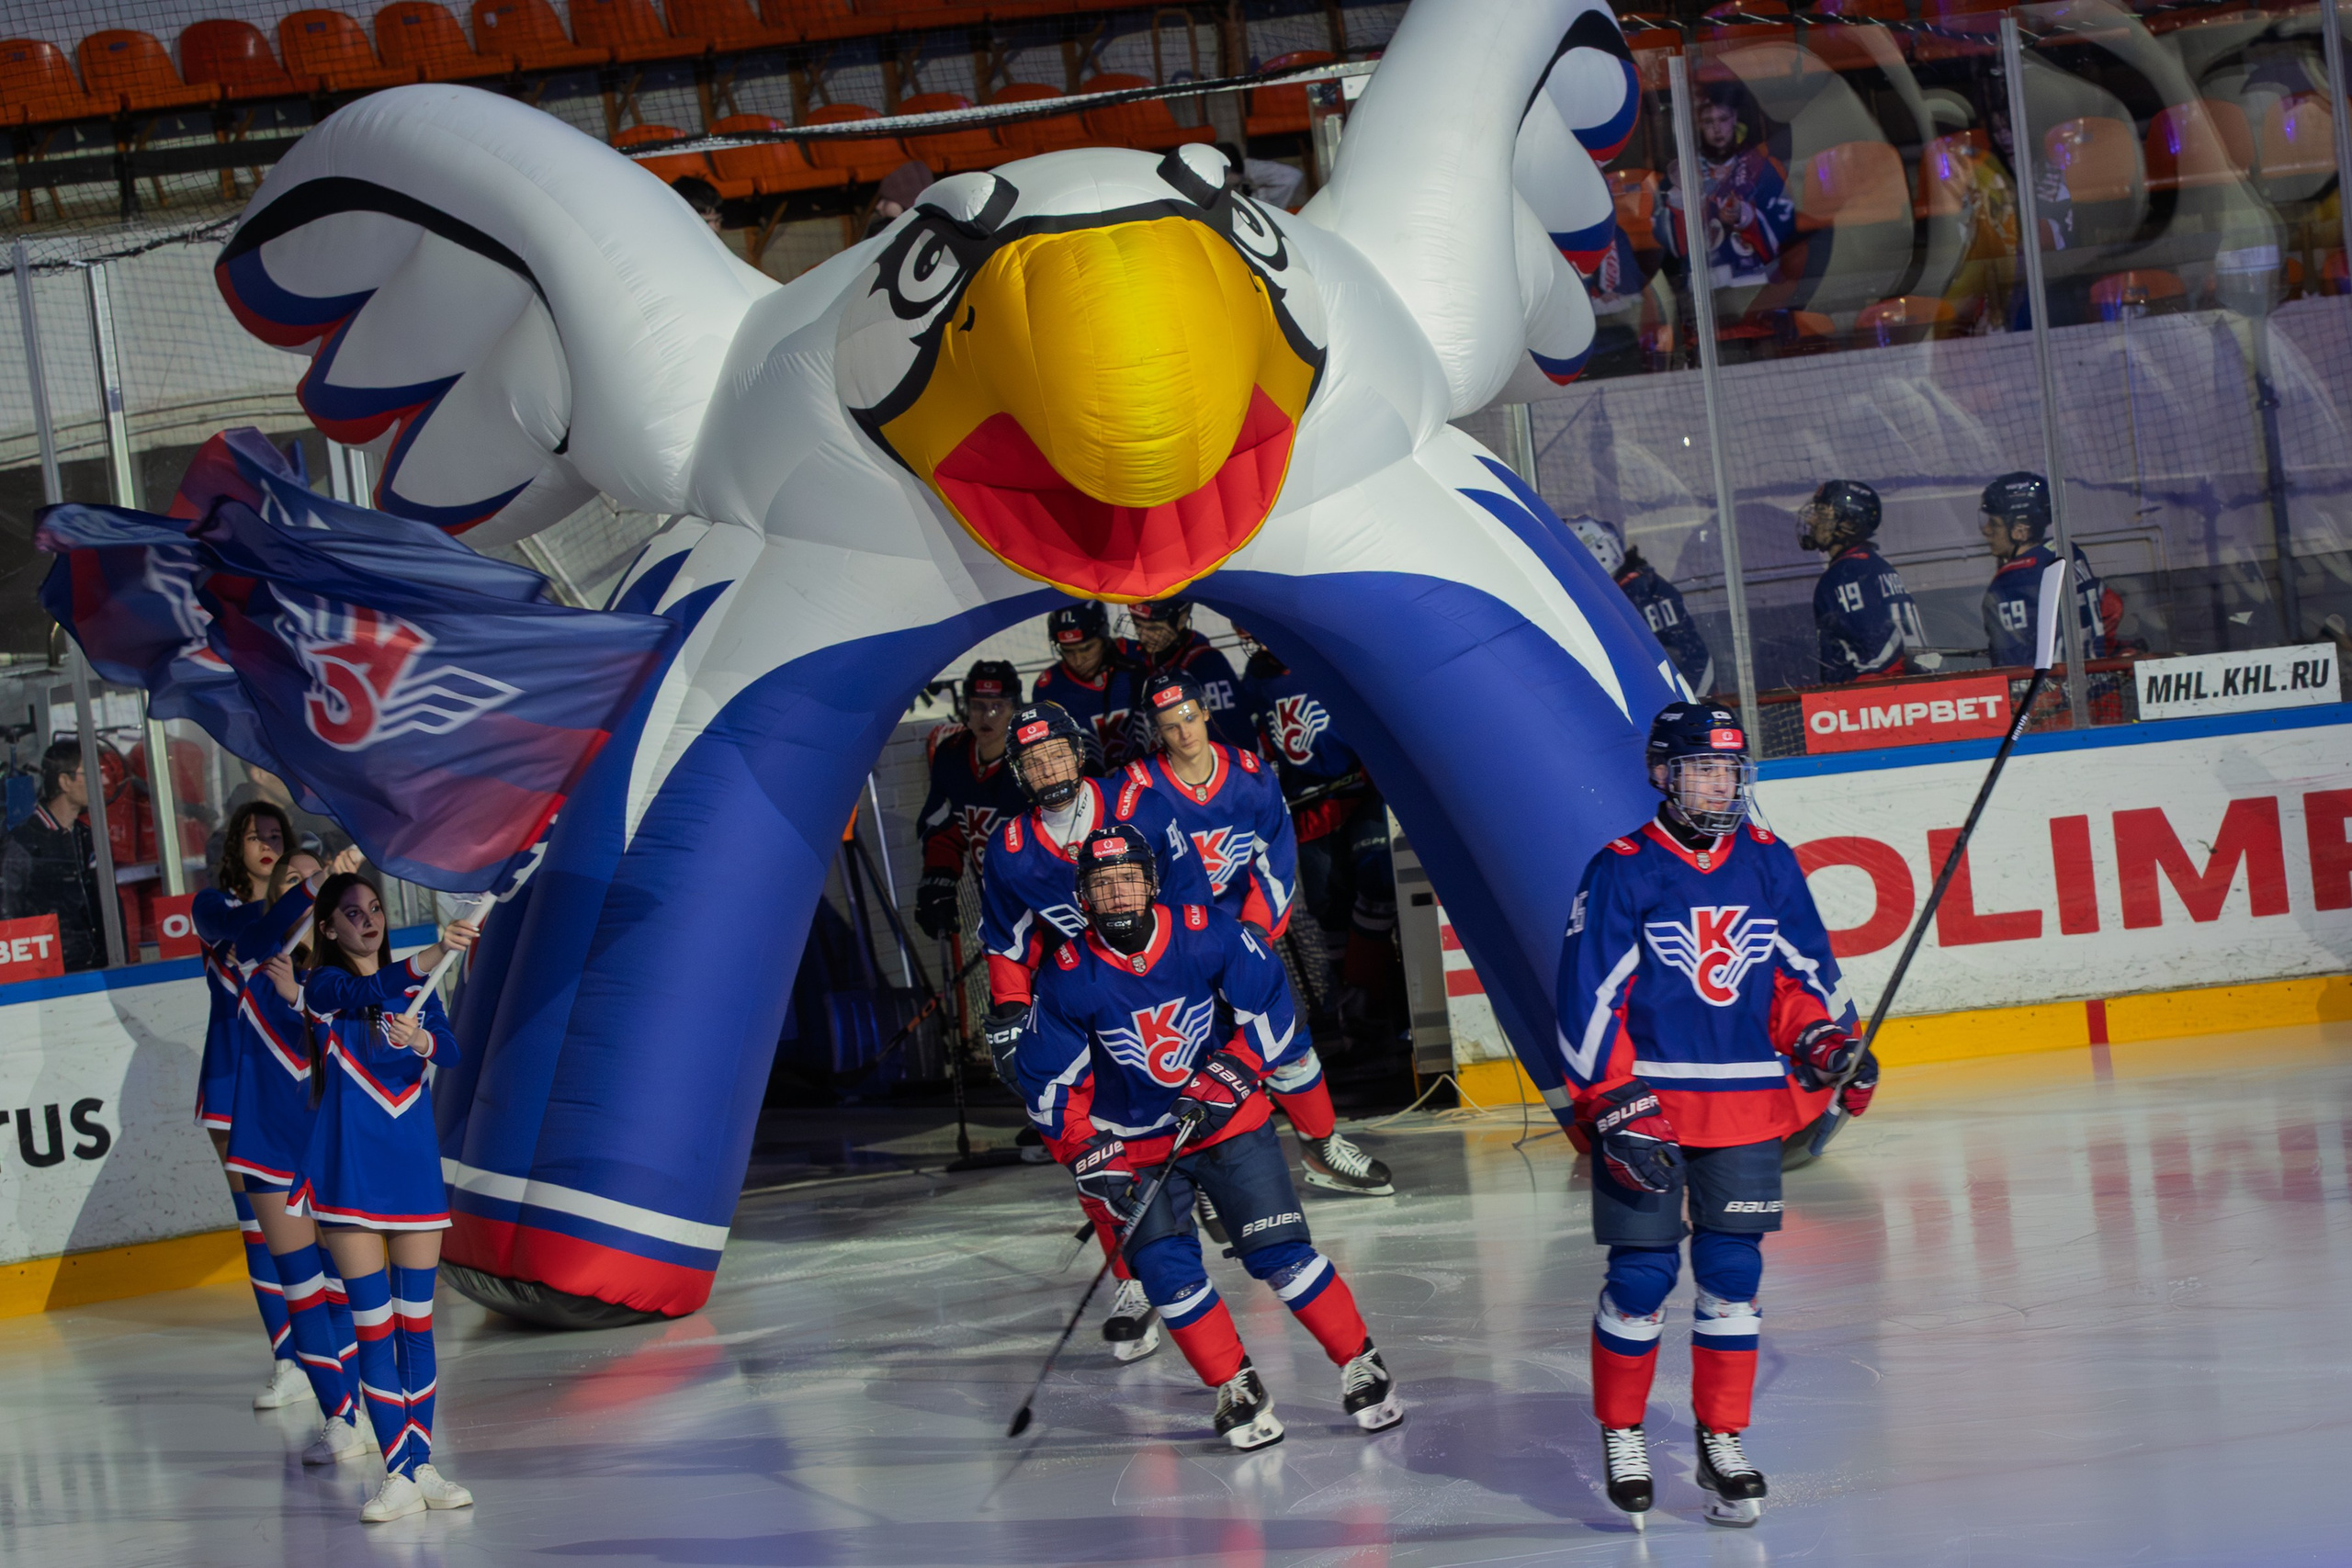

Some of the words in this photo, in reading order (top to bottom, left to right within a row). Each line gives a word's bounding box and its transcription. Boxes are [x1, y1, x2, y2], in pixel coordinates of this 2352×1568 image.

[1998, 600, 2028, 631] 69
[2146, 659, 2330, 705] MHL.KHL.RU
[1810, 695, 2003, 734] OLIMPBET
